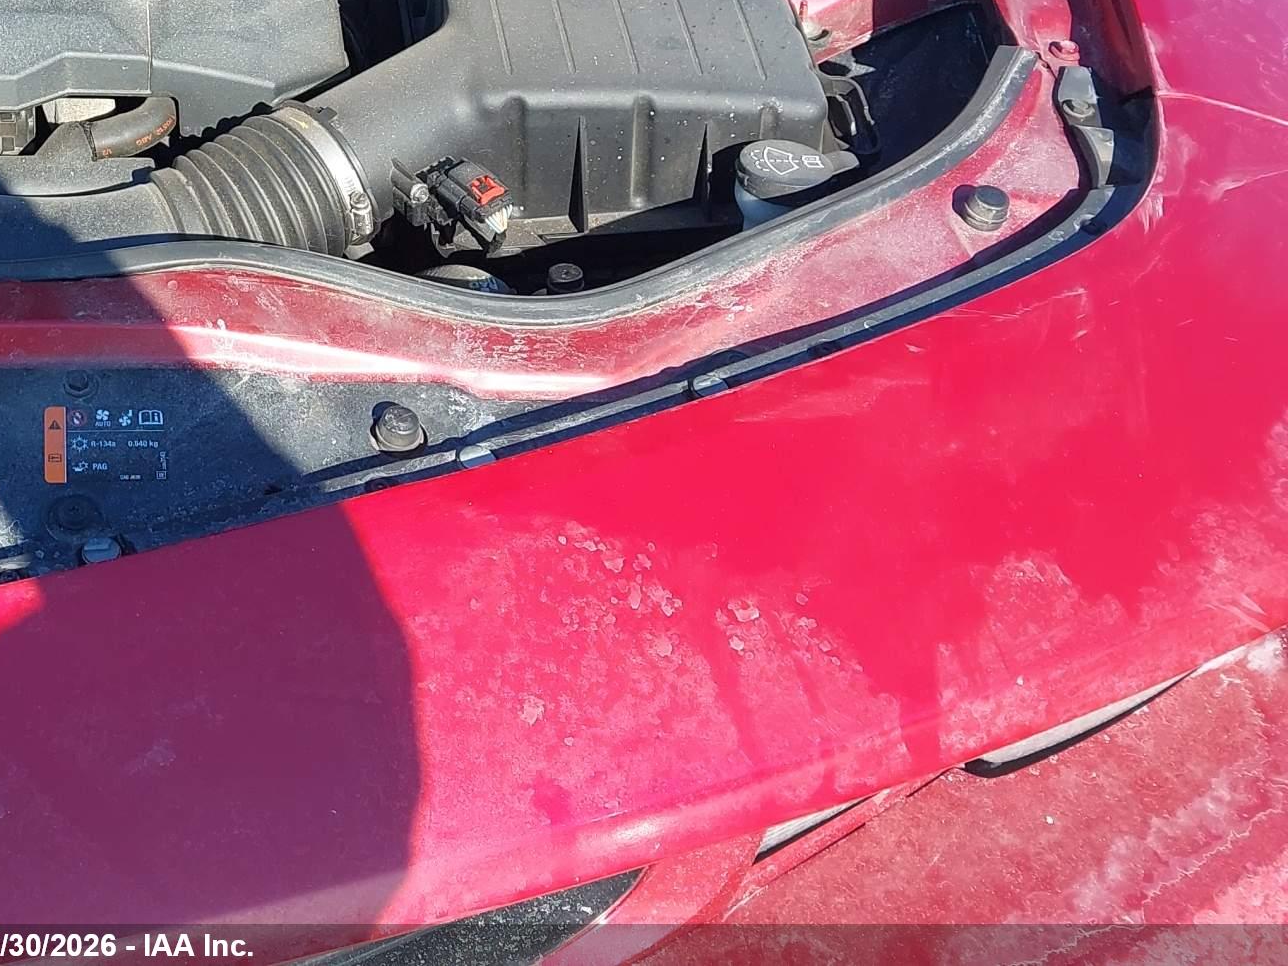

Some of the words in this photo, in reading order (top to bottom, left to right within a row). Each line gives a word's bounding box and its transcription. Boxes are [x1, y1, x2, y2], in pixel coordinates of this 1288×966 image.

[91, 440, 116, 448] R-134a
[149, 439, 159, 449] kg
[92, 463, 108, 471] PAG
